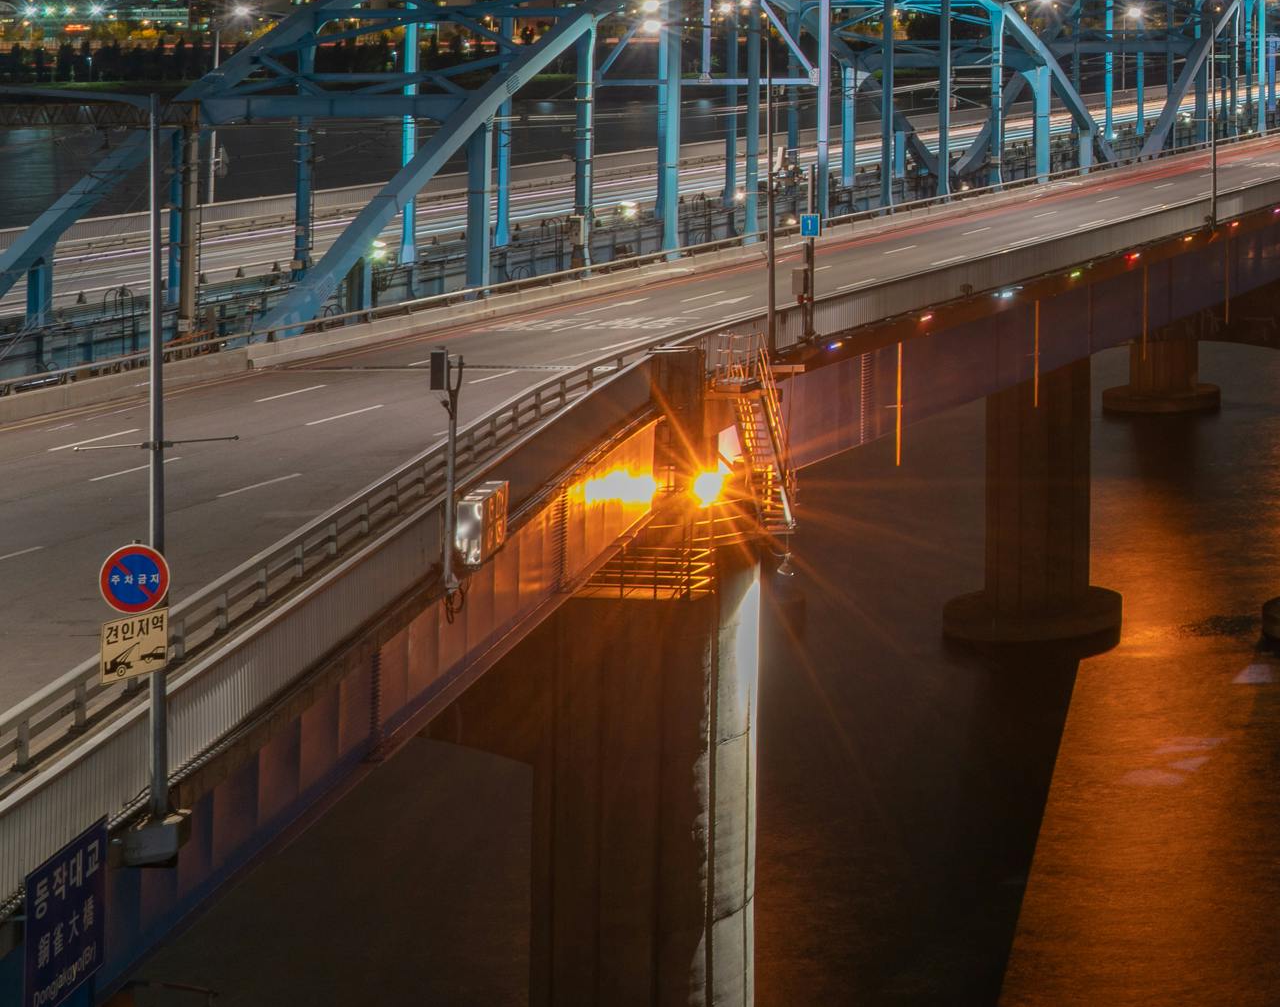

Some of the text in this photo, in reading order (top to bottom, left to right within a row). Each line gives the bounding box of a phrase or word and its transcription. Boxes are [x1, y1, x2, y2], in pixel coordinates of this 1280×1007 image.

[111, 574, 159, 585] 주차금지
[106, 614, 164, 645] 견인지역
[34, 839, 100, 920] 동작대교
